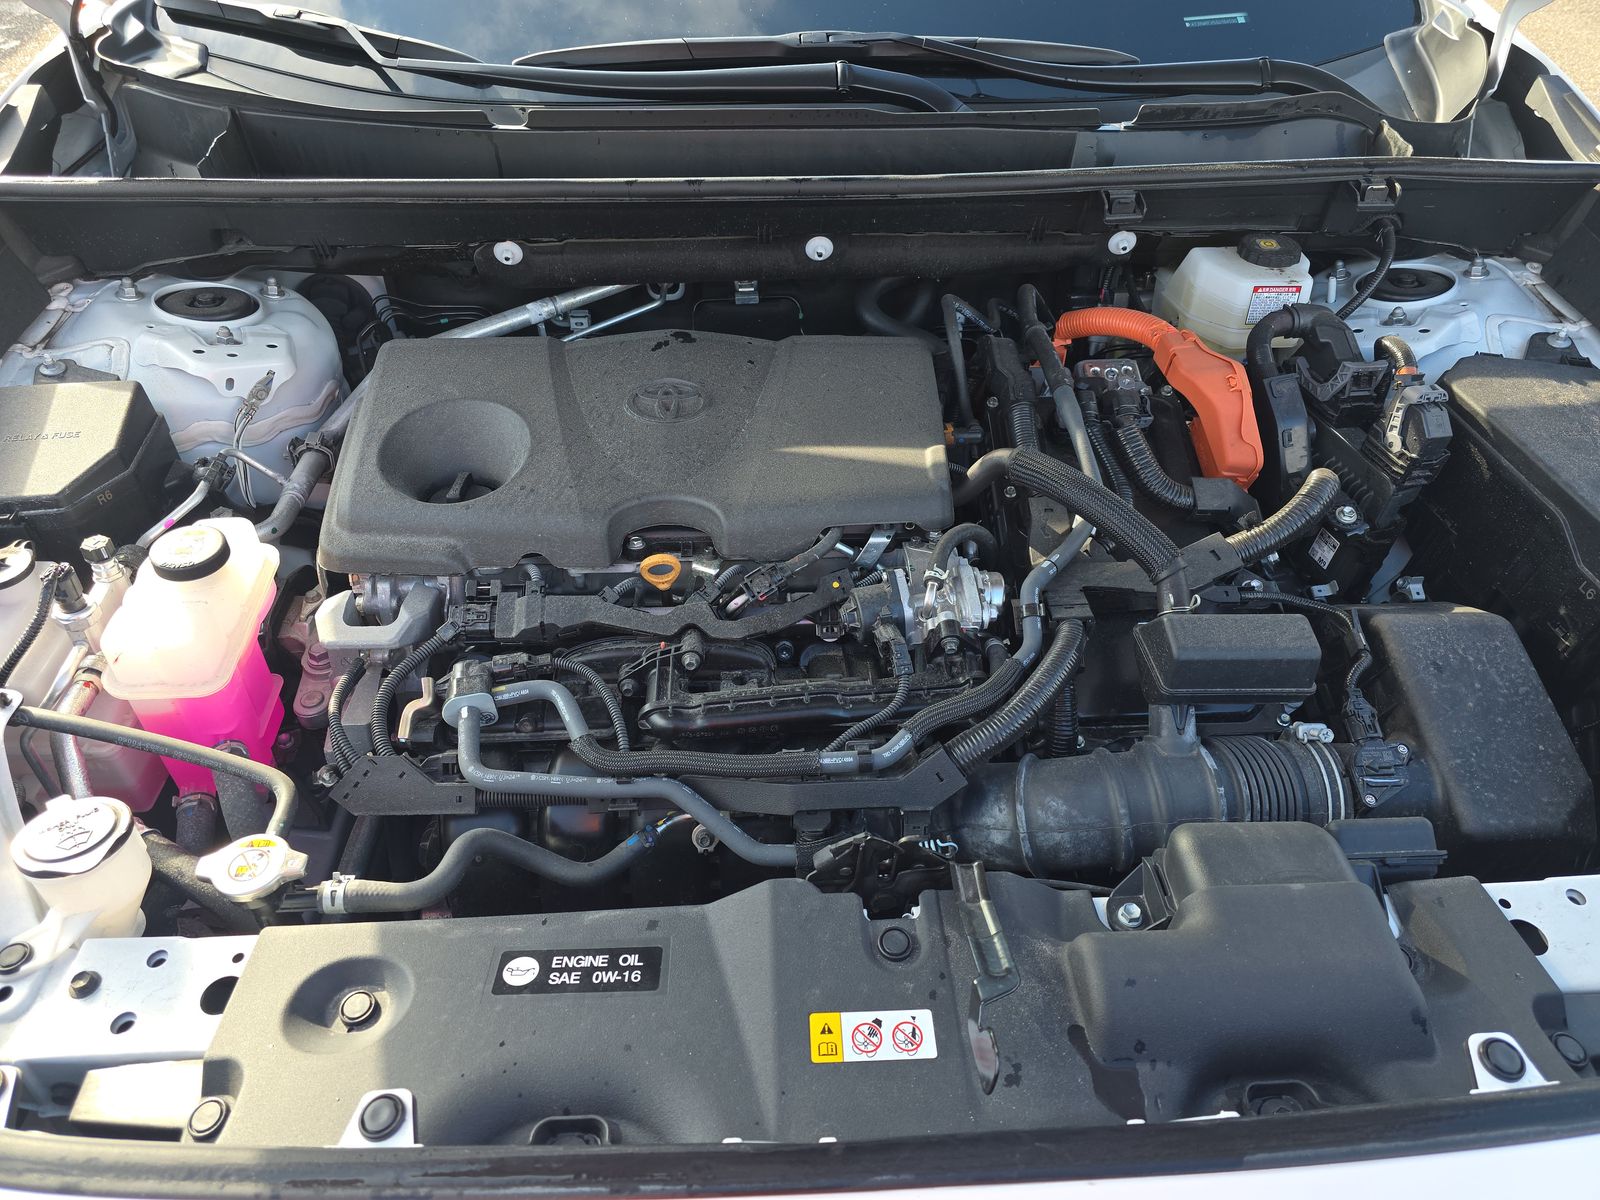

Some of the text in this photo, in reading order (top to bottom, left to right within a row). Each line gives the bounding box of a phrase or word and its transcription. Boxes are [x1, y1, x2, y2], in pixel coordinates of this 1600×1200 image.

[51, 430, 81, 440] FUSE
[97, 489, 113, 505] R6
[551, 953, 644, 968] ENGINE OIL
[548, 970, 642, 985] SAE 0W-16
